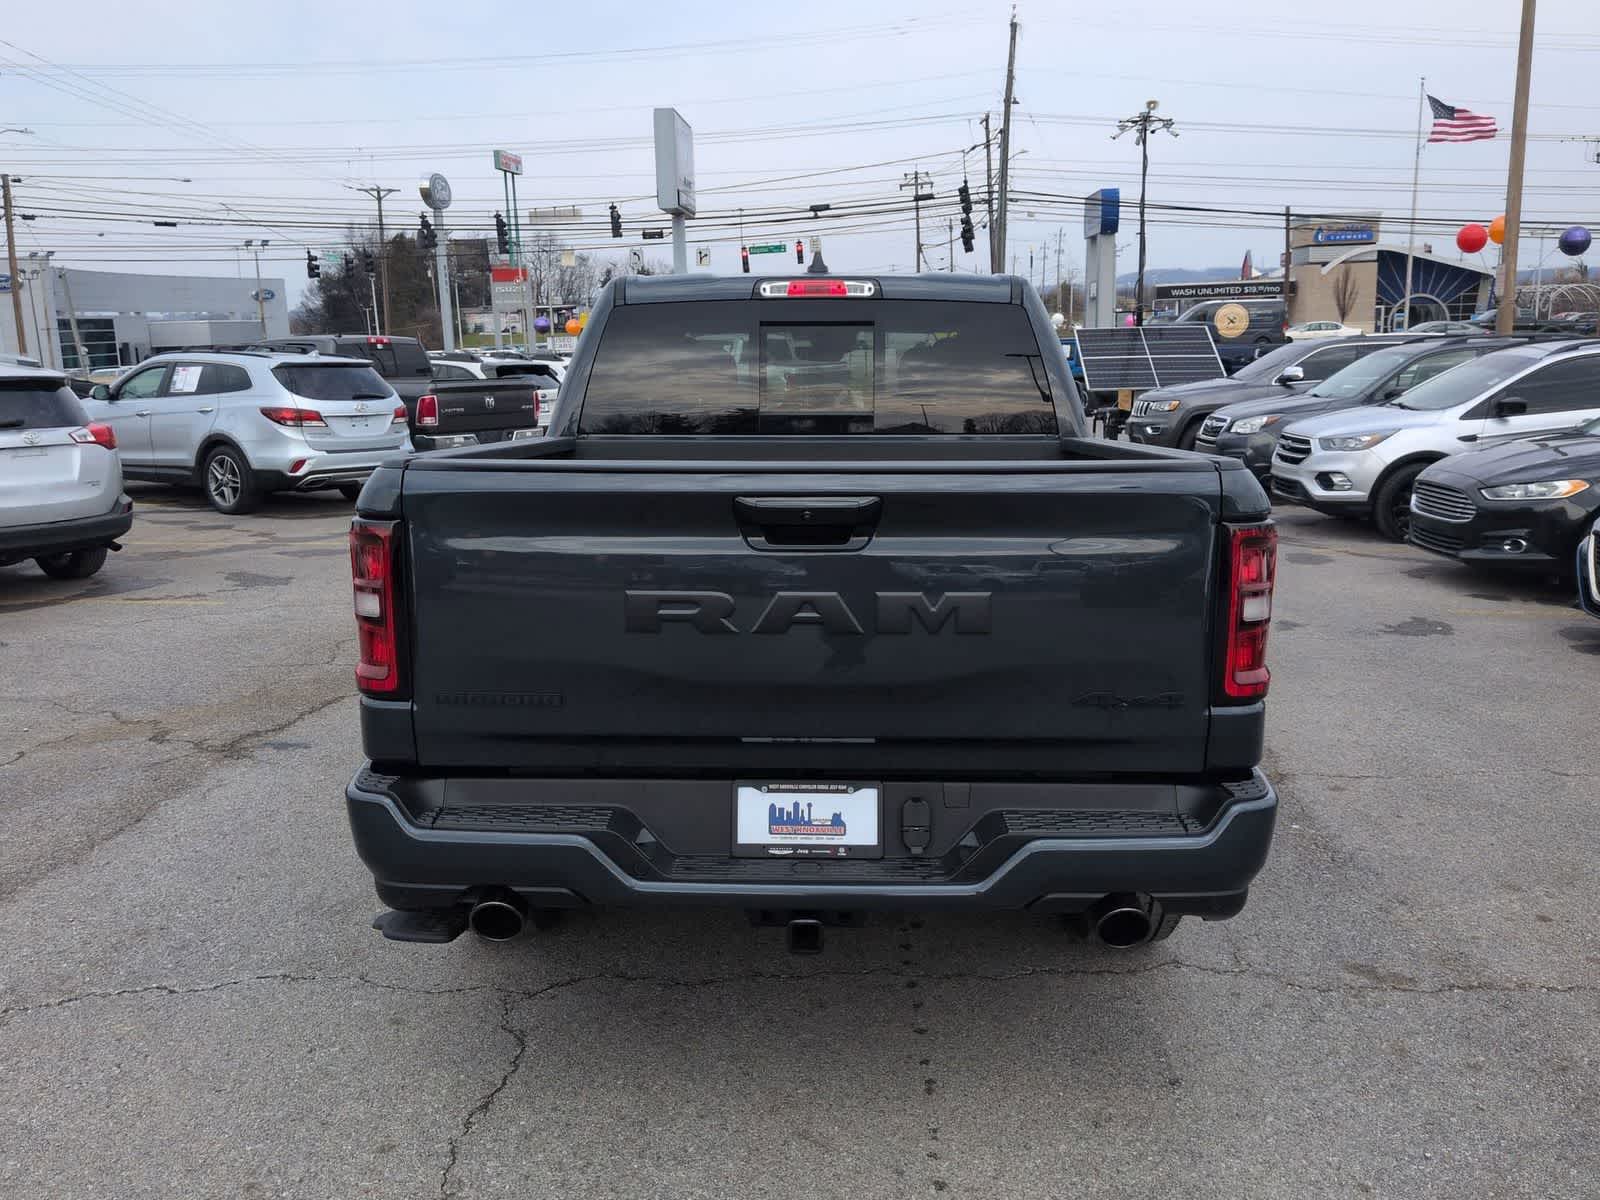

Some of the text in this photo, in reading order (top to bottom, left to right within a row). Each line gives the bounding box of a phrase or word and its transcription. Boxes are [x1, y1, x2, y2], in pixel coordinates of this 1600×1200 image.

[1170, 288, 1195, 296] WASH
[1198, 286, 1241, 295] UNLIMITED
[624, 590, 993, 634] RAM
